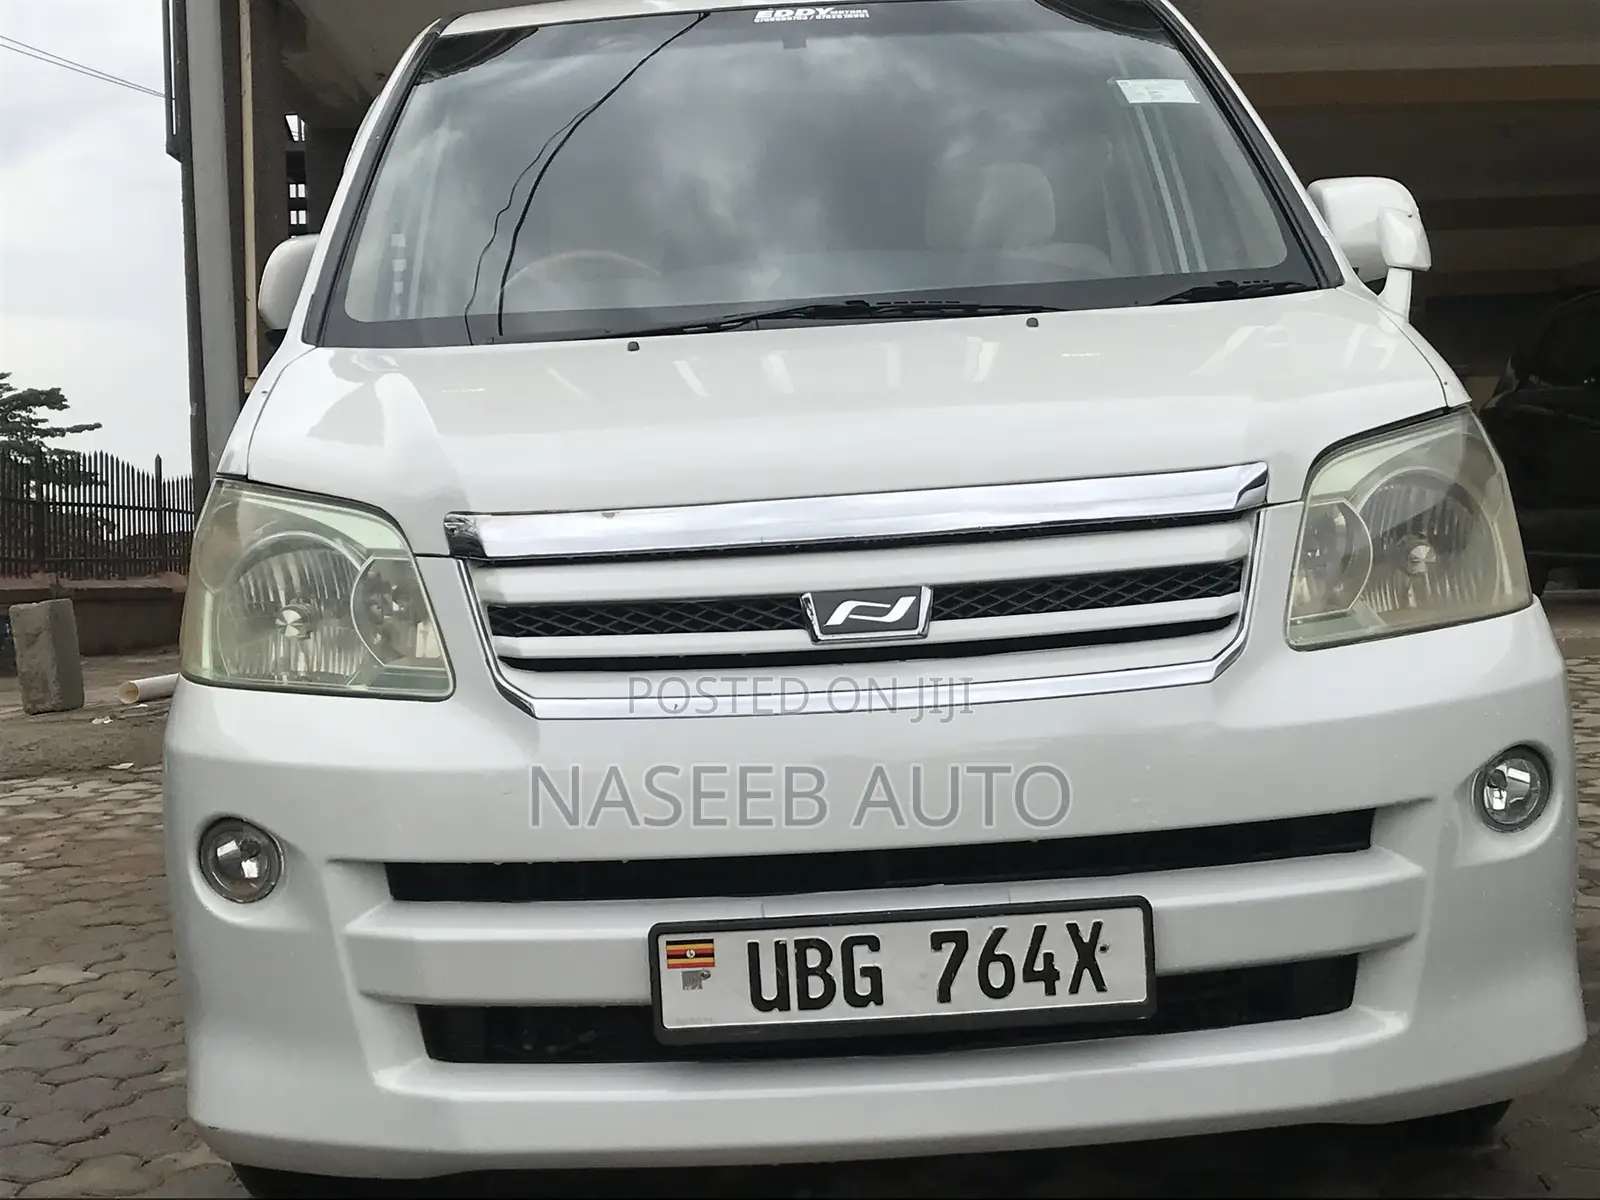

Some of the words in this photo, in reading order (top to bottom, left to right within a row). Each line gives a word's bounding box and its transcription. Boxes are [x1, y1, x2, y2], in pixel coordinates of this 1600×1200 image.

[755, 7, 835, 18] EDDY
[746, 934, 885, 1013] UBG
[929, 920, 1109, 1004] 764X
